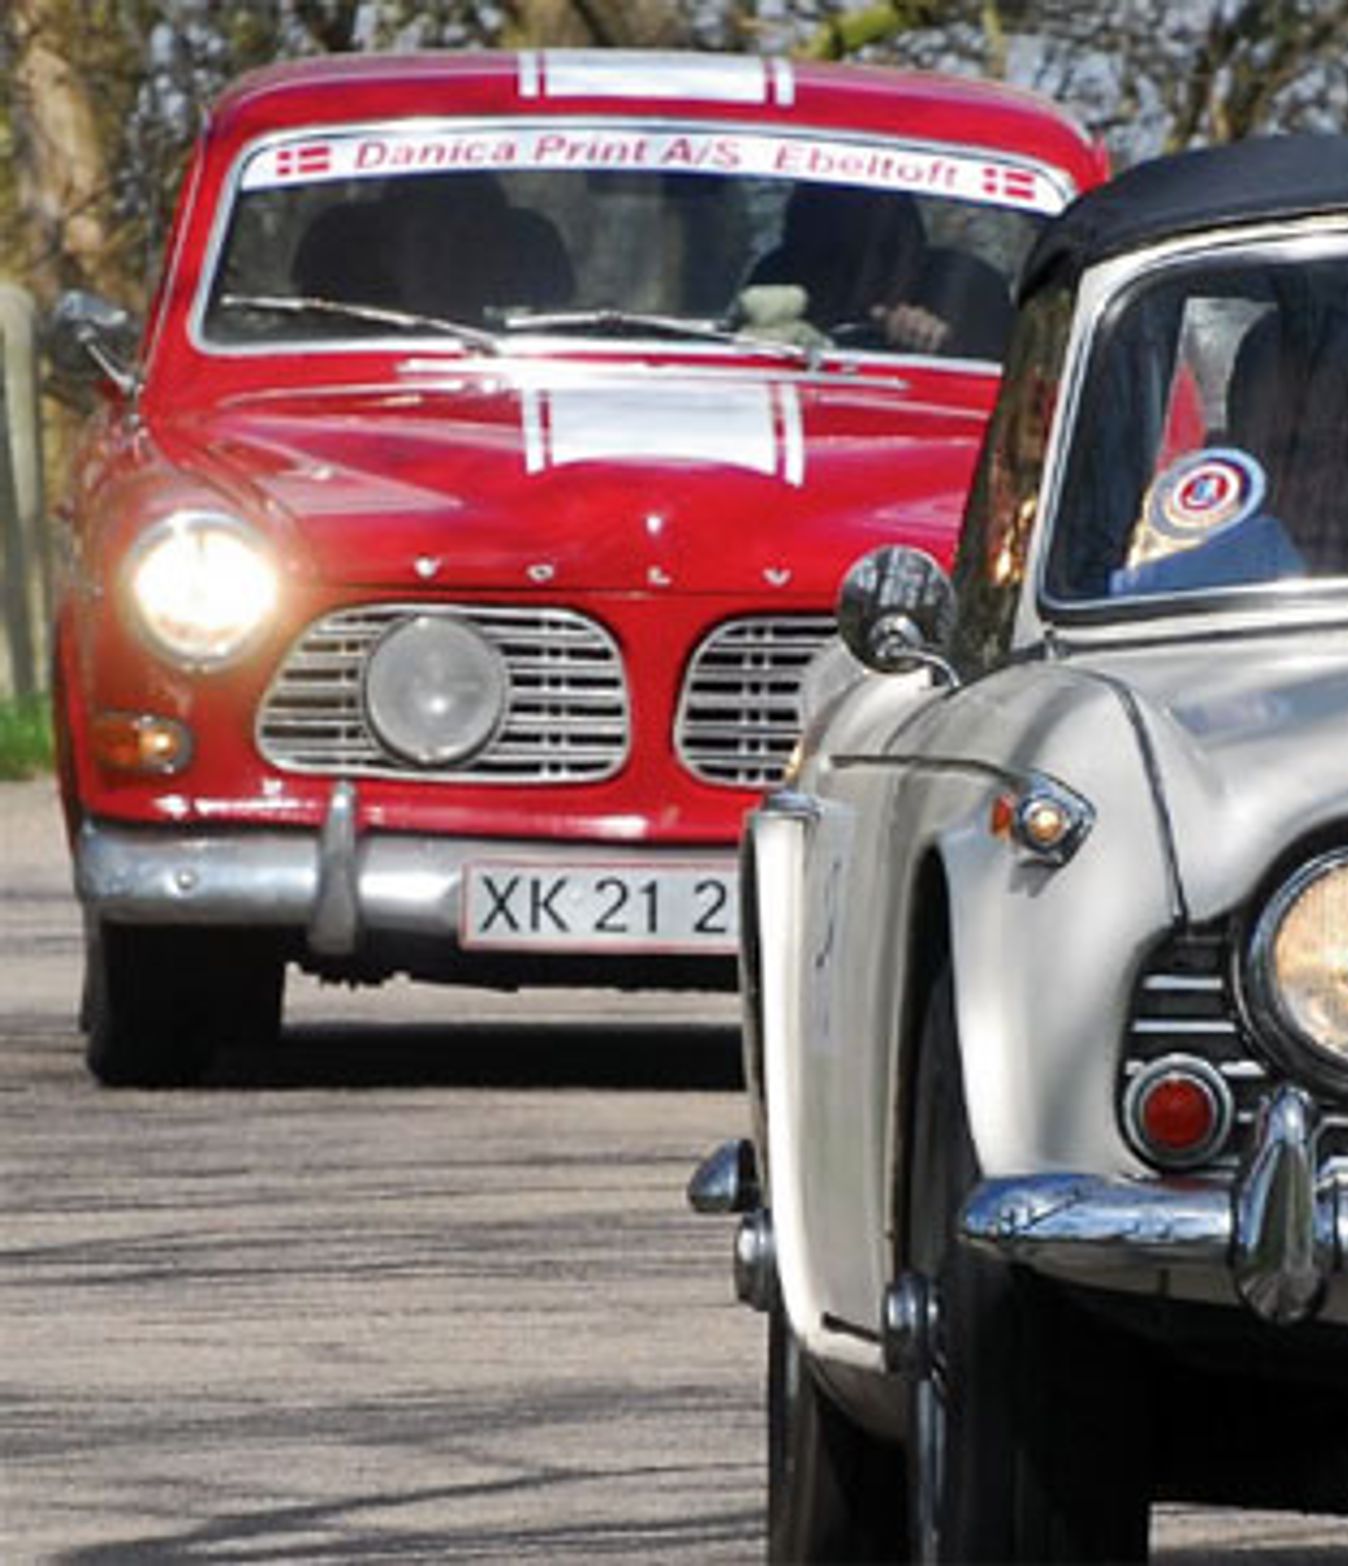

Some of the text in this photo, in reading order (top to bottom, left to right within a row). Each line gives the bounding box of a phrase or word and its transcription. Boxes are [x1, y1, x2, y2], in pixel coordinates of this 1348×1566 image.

[354, 134, 958, 187] Danica Print A/S Ebeltoft
[413, 555, 793, 588] VOLV
[478, 875, 728, 934] XK 21 2
